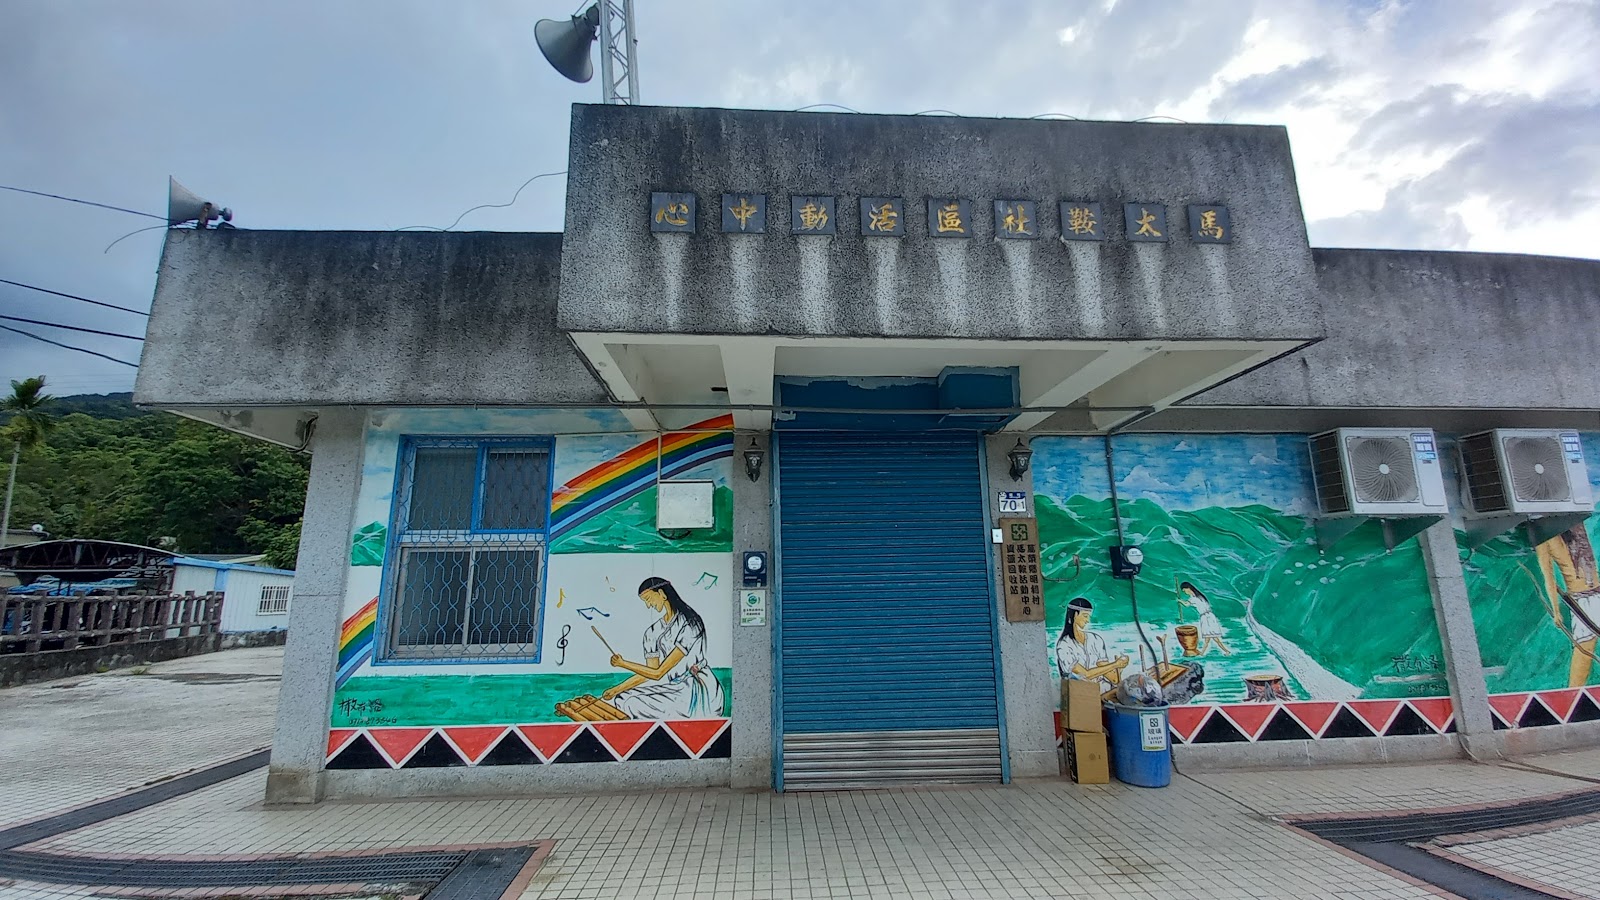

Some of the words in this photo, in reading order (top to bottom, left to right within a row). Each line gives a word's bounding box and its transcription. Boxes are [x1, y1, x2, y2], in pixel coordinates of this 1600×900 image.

[654, 197, 1224, 241] 馬太鞍社區活動中心
[1016, 544, 1031, 615] 馬太鞍活動中心
